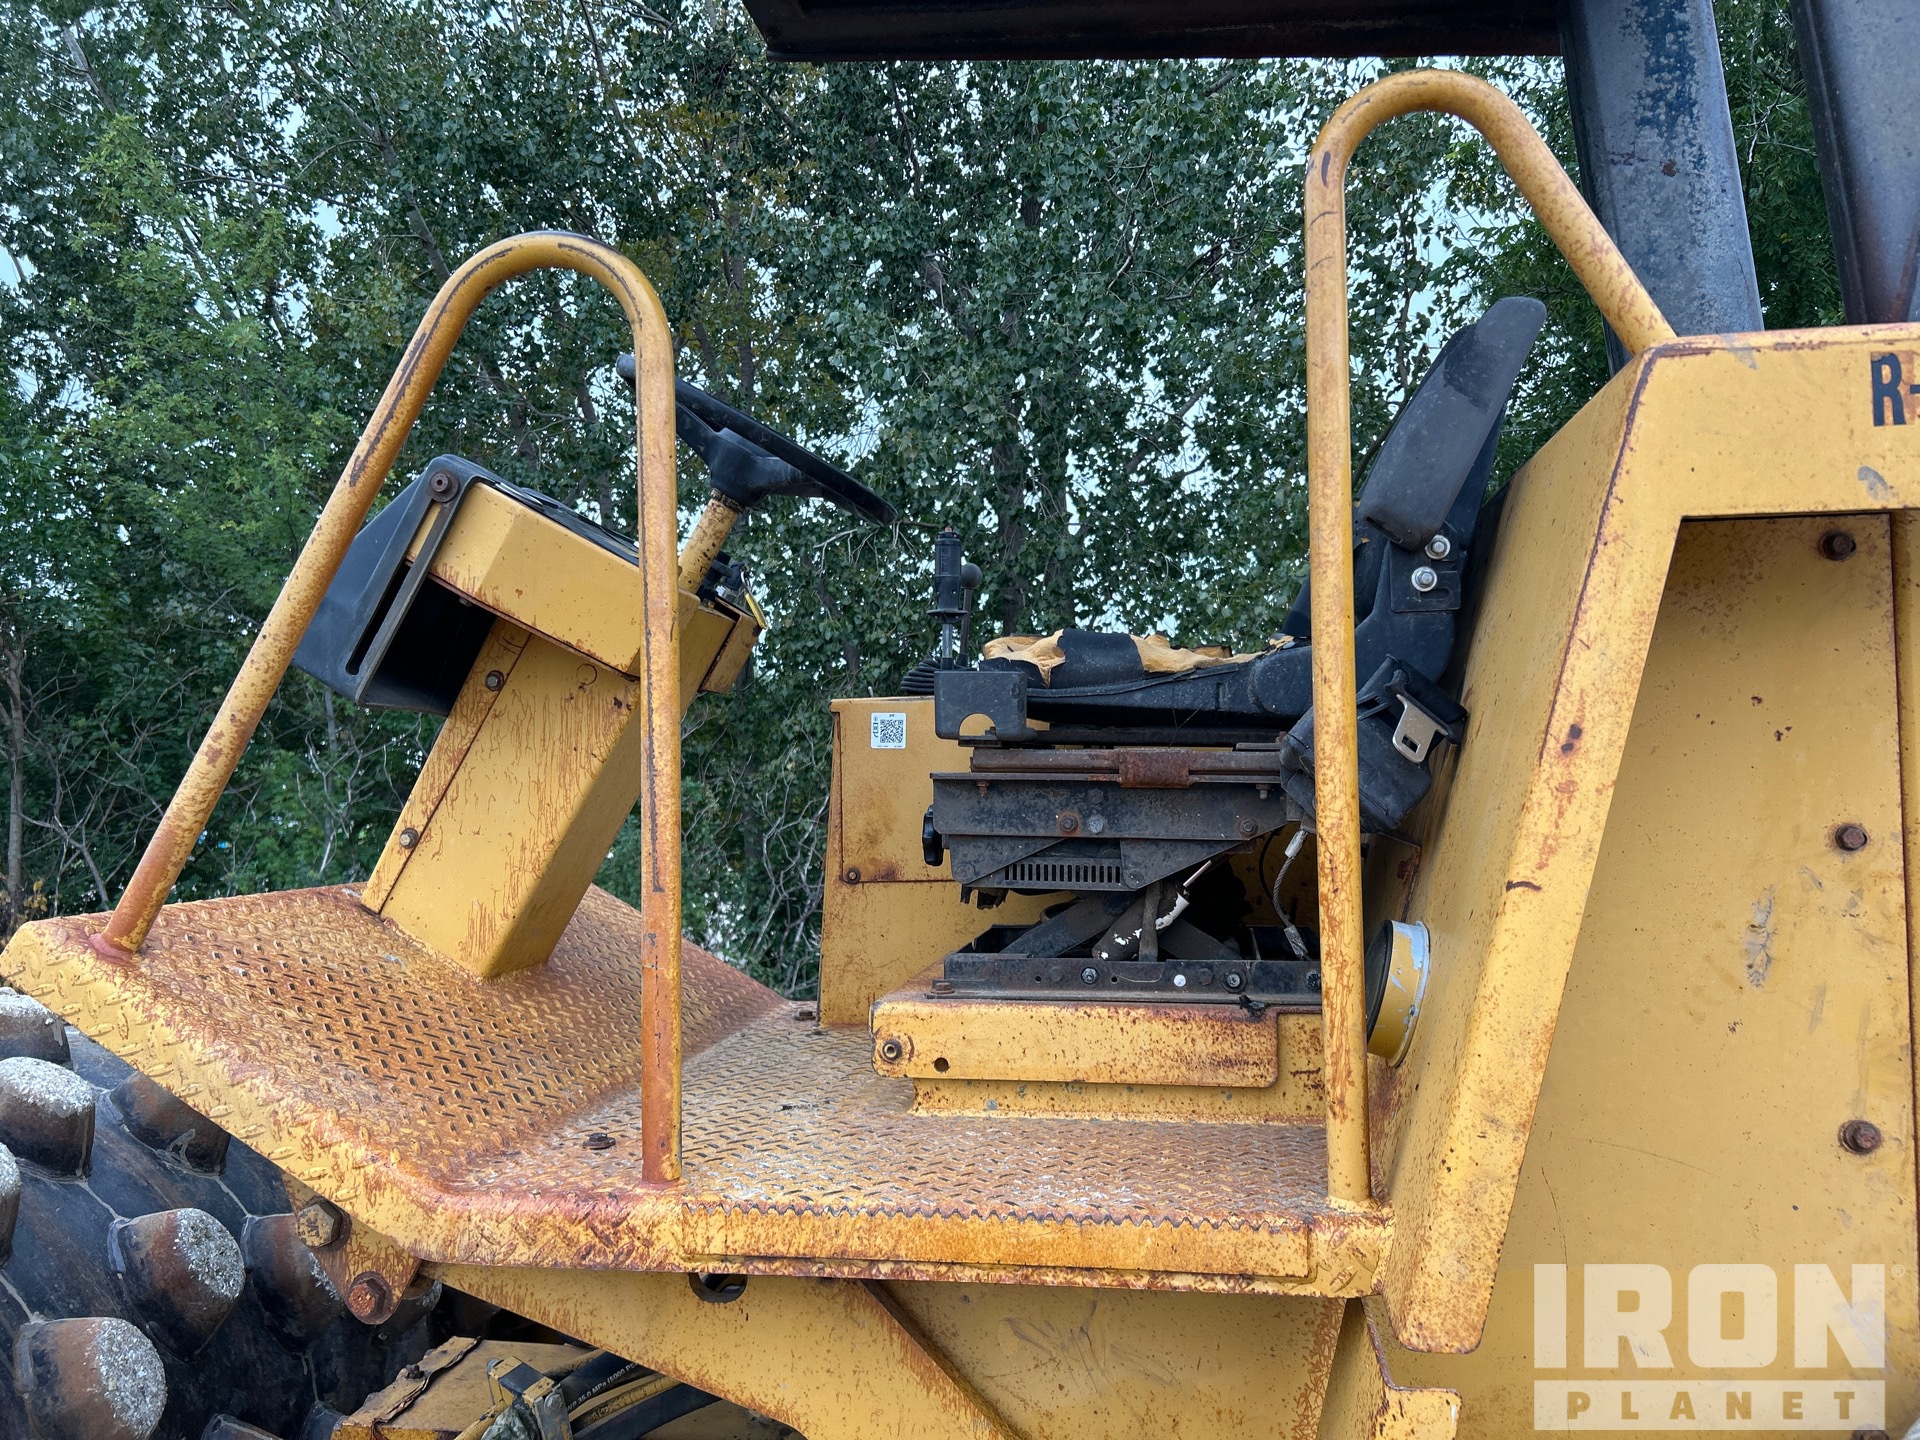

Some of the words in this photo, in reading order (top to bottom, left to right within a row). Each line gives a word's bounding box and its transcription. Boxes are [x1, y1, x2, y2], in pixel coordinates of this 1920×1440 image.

[577, 1391, 592, 1404] 35.0
[592, 1382, 607, 1394] MPa
[607, 1369, 626, 1384] (5000
